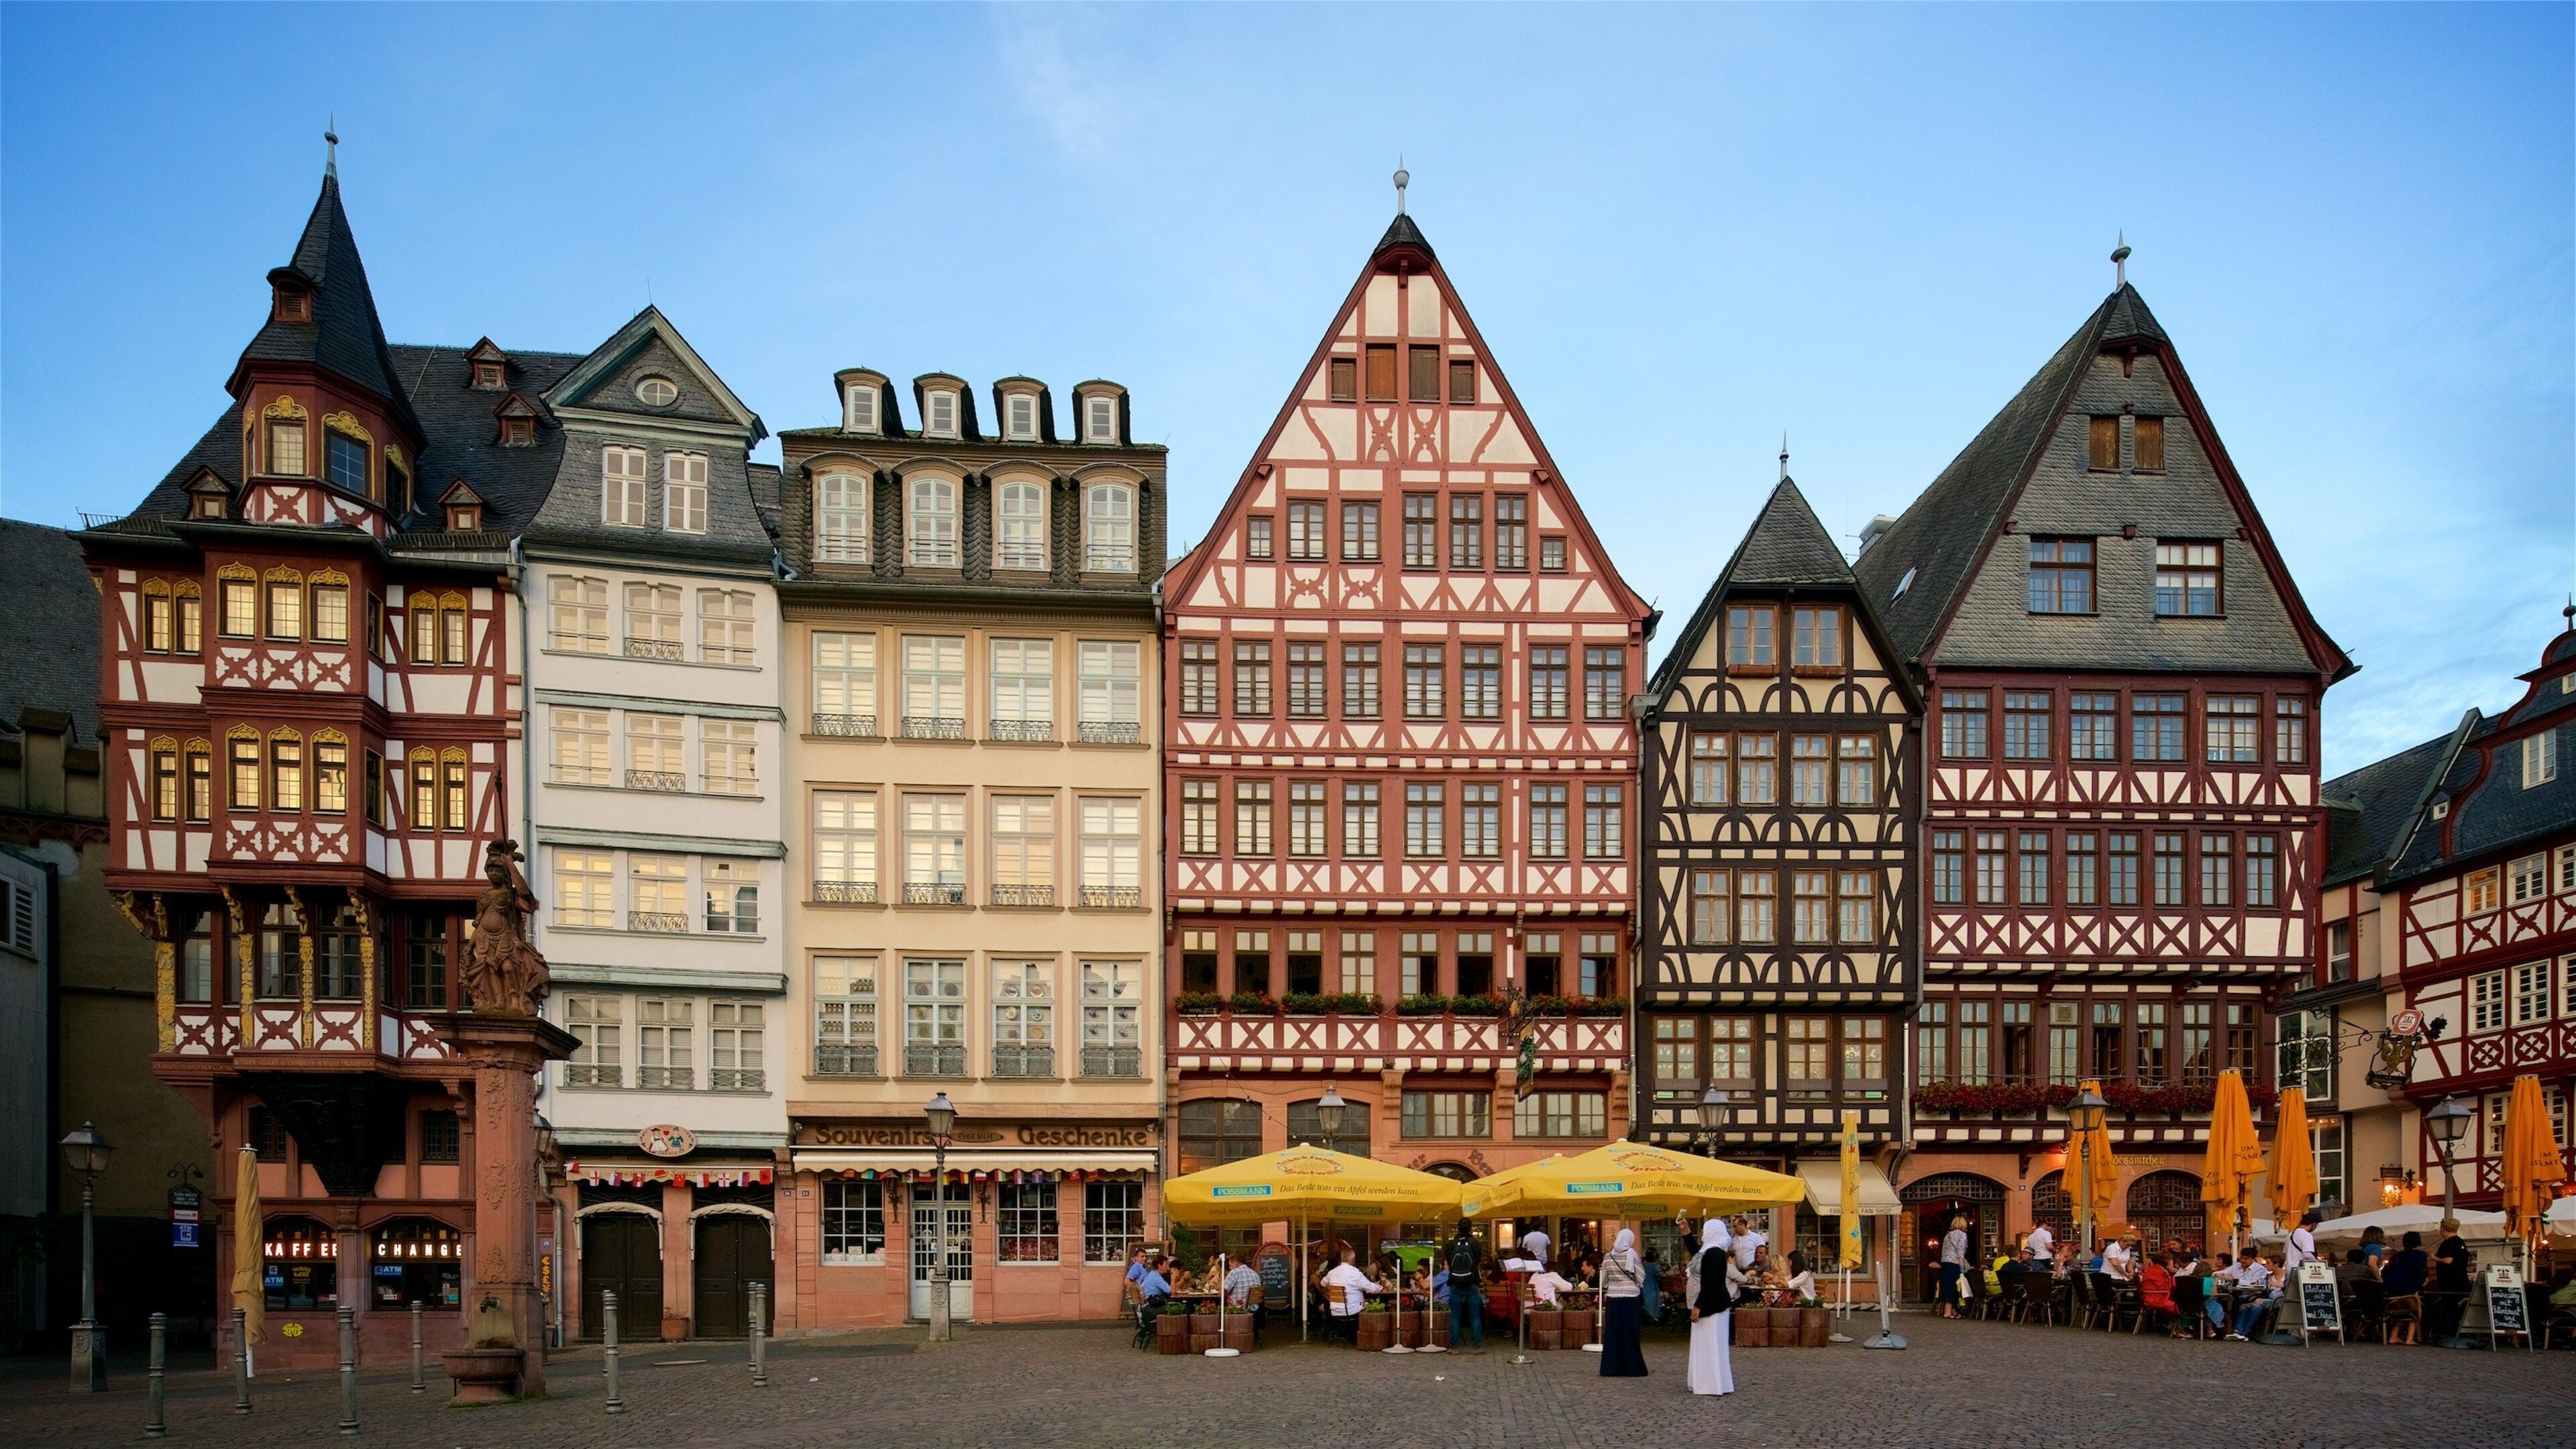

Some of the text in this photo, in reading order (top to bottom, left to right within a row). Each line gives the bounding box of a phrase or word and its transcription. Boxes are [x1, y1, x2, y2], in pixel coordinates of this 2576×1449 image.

[815, 1125, 934, 1144] Souvenirs
[1017, 1126, 1147, 1146] Geschenke
[2113, 1154, 2164, 1166] desämtchen
[1218, 1187, 1267, 1195] POSSMANN
[1279, 1185, 1295, 1193] Das
[1296, 1183, 1316, 1191] Beste
[1347, 1186, 1366, 1195] Apfel
[1368, 1186, 1395, 1194] werden
[1397, 1187, 1419, 1195] kann.
[1571, 1184, 1619, 1192] POSSMANN
[1695, 1183, 1712, 1192] Apfel
[1714, 1185, 1740, 1193] werden
[265, 1243, 337, 1256] KAFFEE
[378, 1243, 462, 1256] CHANGE
